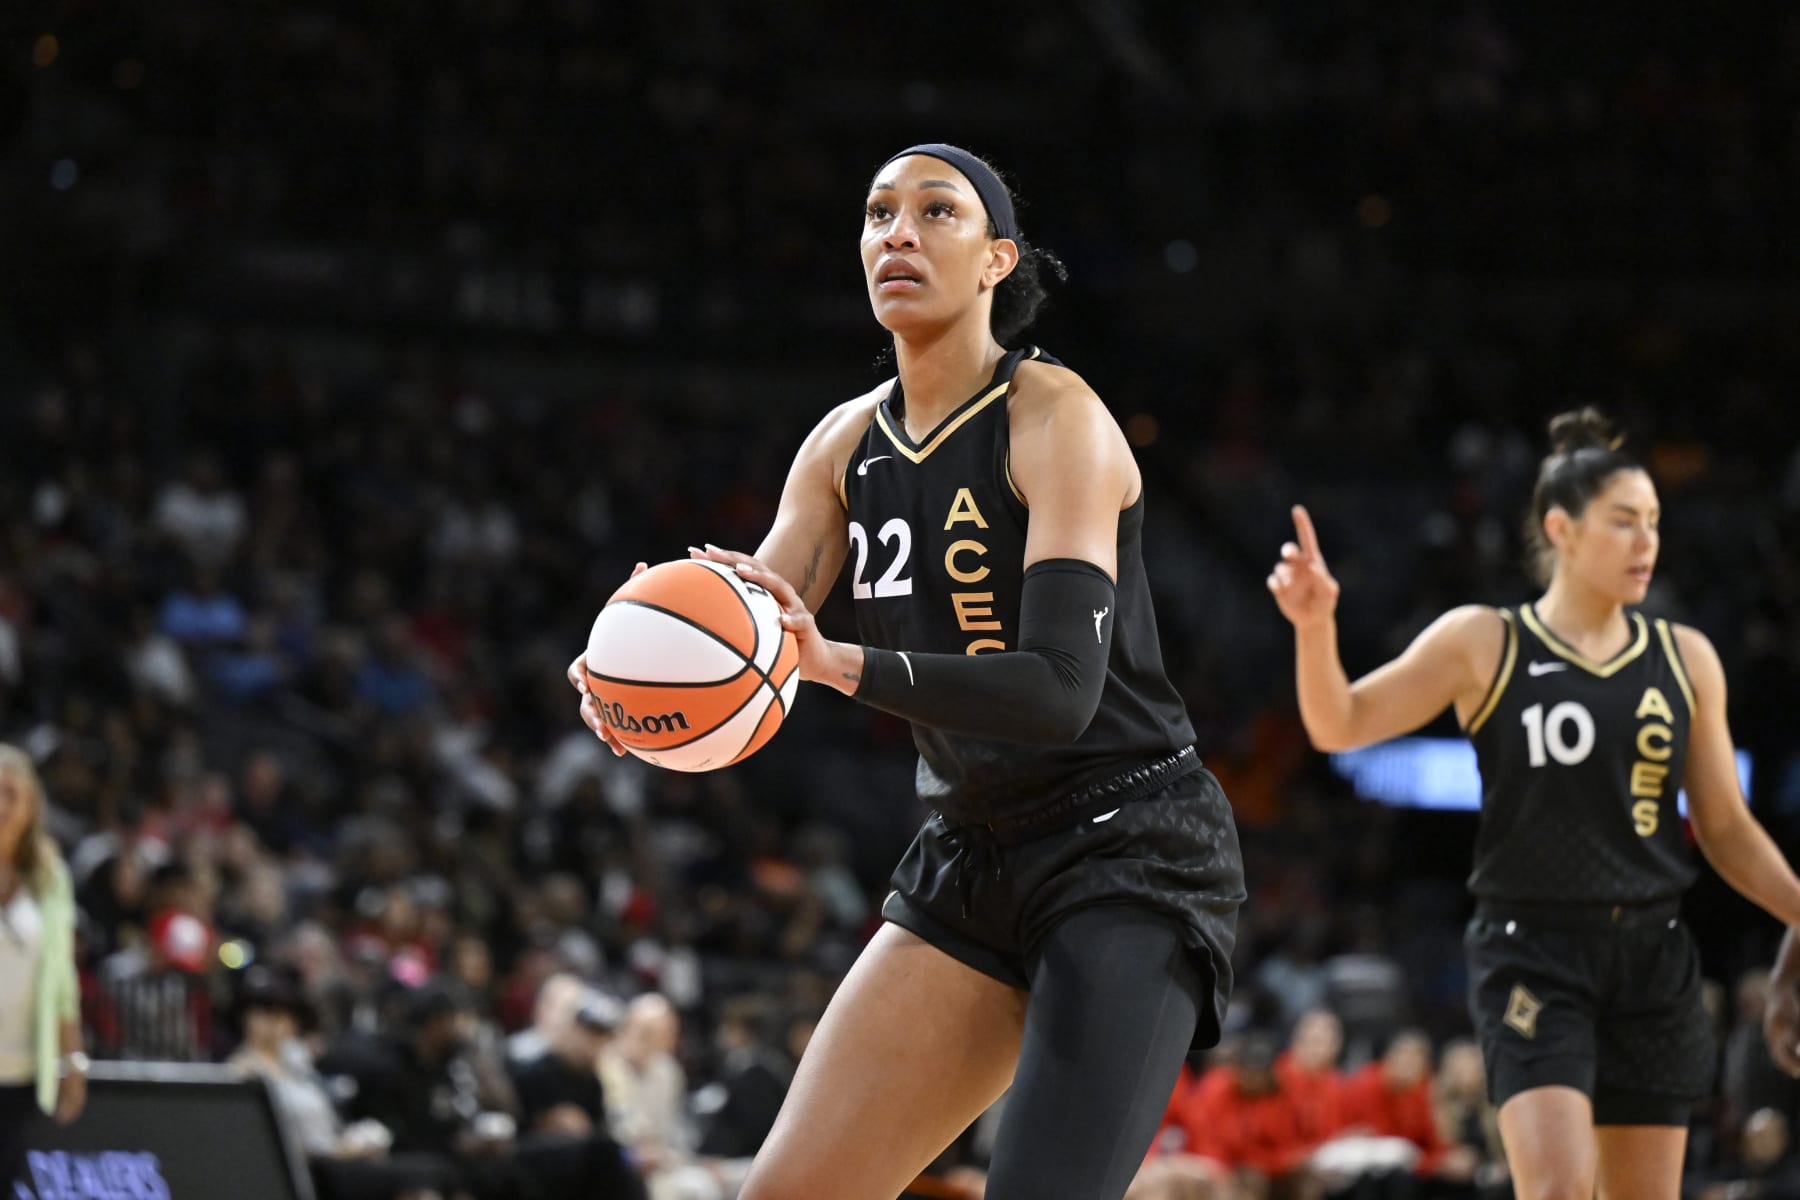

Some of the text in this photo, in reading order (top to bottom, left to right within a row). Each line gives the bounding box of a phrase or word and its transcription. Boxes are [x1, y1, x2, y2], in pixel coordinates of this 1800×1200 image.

[848, 517, 913, 600] 22
[1521, 701, 1596, 768] 10
[1629, 686, 1675, 837] ACES
